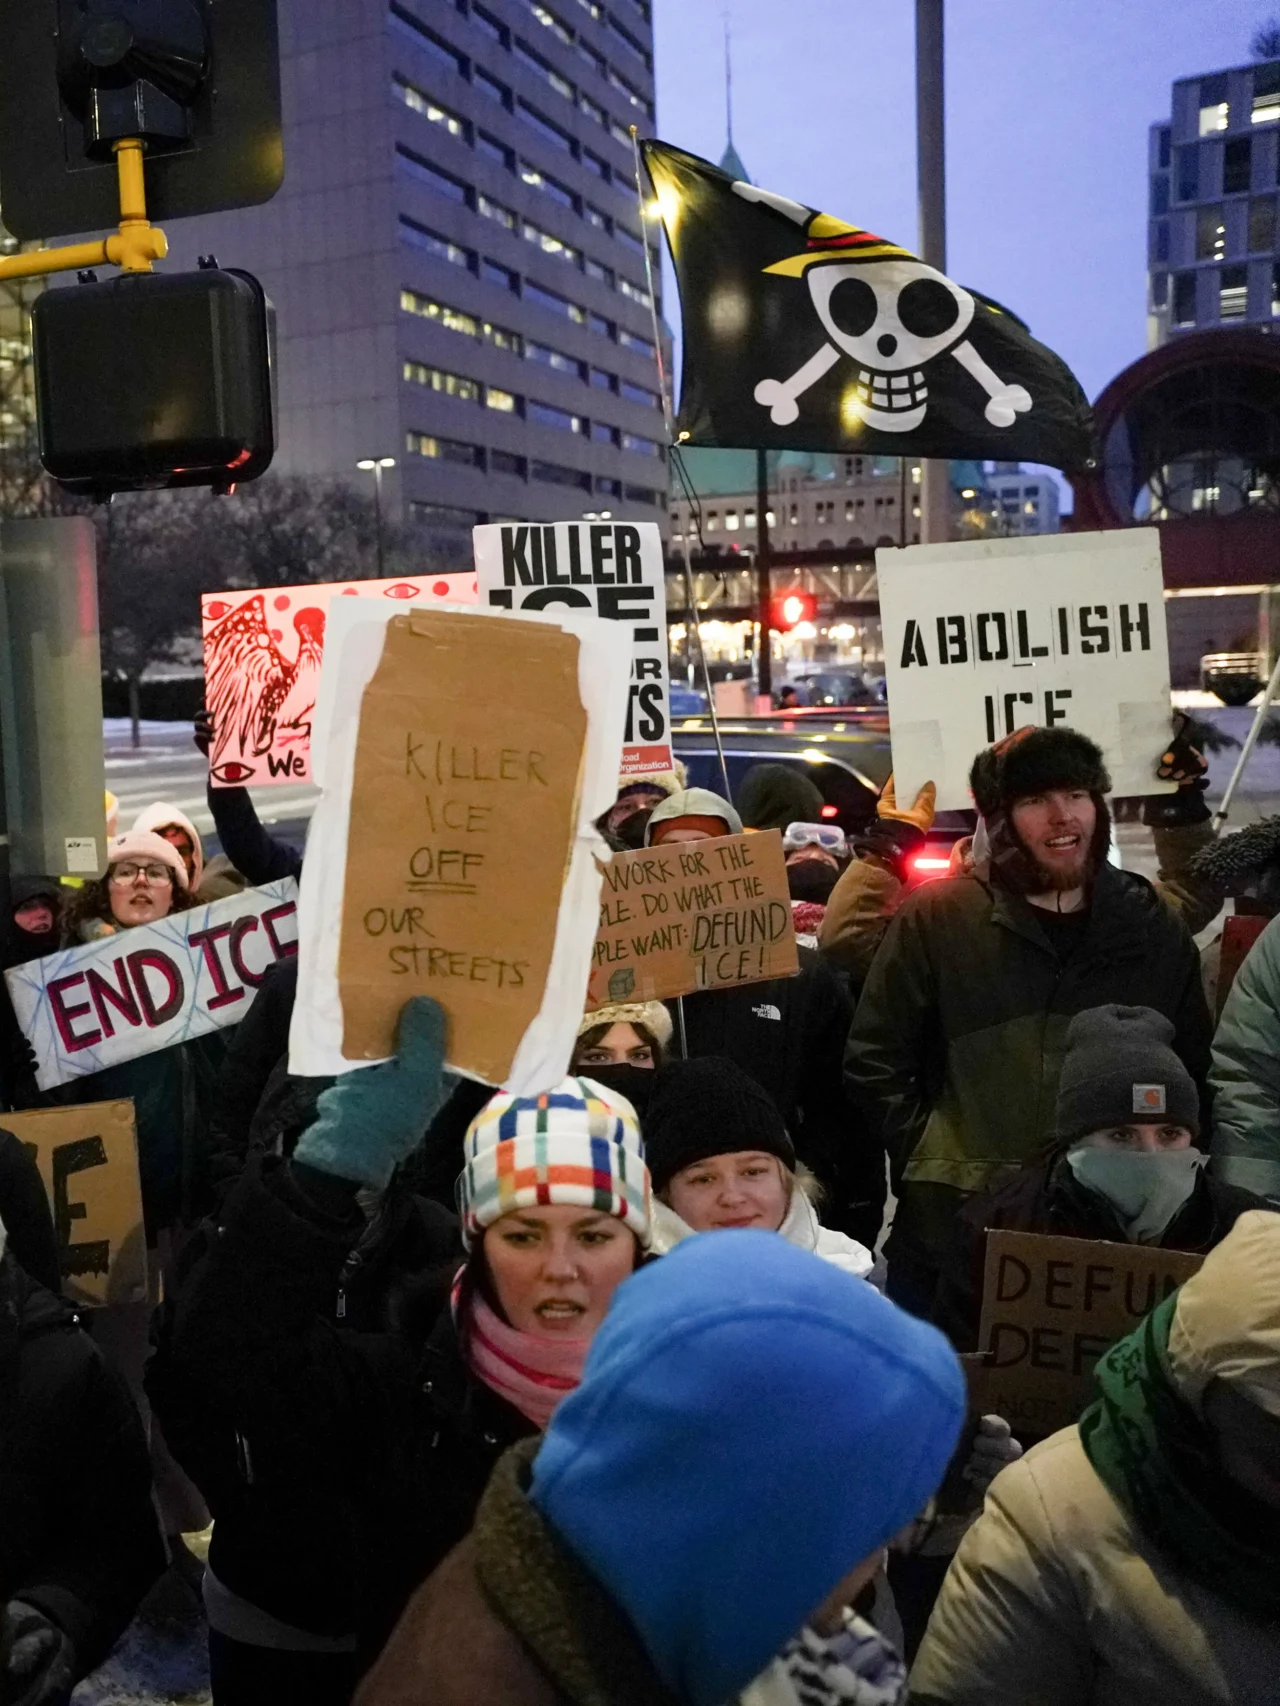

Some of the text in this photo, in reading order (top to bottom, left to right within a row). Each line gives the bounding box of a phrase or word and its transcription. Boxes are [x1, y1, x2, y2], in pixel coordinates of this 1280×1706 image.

[500, 525, 642, 586] KILLER
[900, 602, 1151, 668] ABOLISH
[629, 658, 663, 680] R
[984, 689, 1072, 743] ICE
[267, 750, 307, 777] We
[405, 732, 549, 787] KILLER
[424, 795, 493, 833] ICE
[409, 846, 485, 880] OFF
[603, 843, 754, 893] WORK FOR THE
[641, 892, 669, 917] DO
[673, 881, 724, 913] WHAT
[728, 876, 765, 901] THE
[362, 906, 435, 937] OUR
[591, 939, 630, 966] PLE
[693, 902, 788, 952] DEFUND
[388, 945, 530, 988] STREETS
[45, 948, 185, 1054] END
